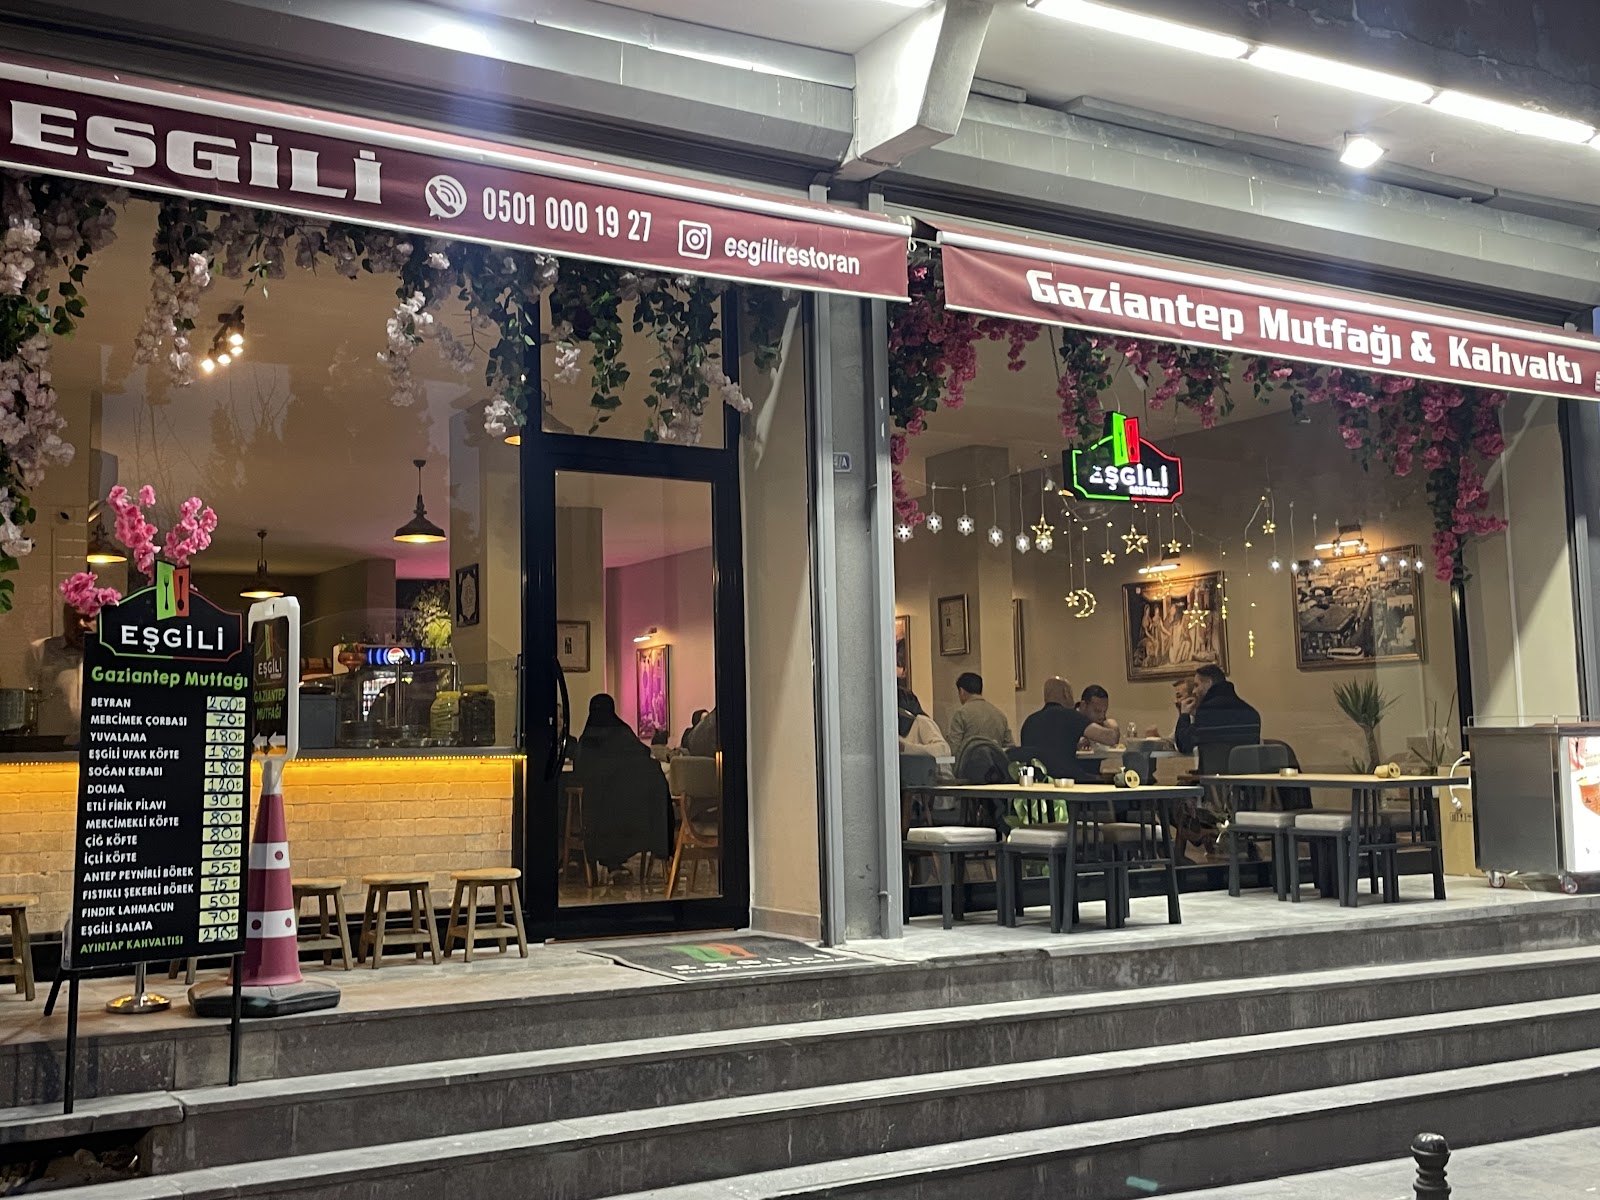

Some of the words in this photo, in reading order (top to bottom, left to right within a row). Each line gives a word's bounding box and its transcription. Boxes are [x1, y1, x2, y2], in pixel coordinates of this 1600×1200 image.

[10, 99, 382, 205] EŞGİLİ
[482, 186, 536, 226] 0501
[545, 196, 588, 234] 000
[595, 204, 620, 240] 19
[628, 210, 652, 243] 27
[724, 234, 860, 275] esgilirestoran
[1026, 269, 1244, 342] Gaziantep
[1258, 305, 1402, 366] Mutfağı
[1410, 330, 1434, 365] &
[1449, 335, 1582, 385] Kahvaltı
[121, 625, 224, 653] EŞGİLİ
[258, 656, 282, 679] EŞGİLİ
[91, 666, 180, 688] Gaziantep
[184, 671, 248, 691] Mutfağı
[91, 697, 131, 708] BEYRAN
[90, 712, 143, 725] MERCİMEK
[145, 716, 188, 727] ÇORBASI
[90, 732, 147, 742] YUVALAMA
[88, 746, 120, 760] EŞGİLİ
[122, 750, 147, 759] UFAK
[149, 747, 180, 759] KÖFTE
[88, 764, 126, 776] SOĞAN
[128, 766, 163, 776] KEBABI
[87, 784, 125, 794] DOLMA
[86, 798, 106, 812] ETLİ
[108, 798, 133, 811] FİRİK
[135, 798, 166, 811] PİLAVI
[85, 815, 147, 829] MERCİMEKLİ
[149, 814, 179, 827] KÖFTE
[85, 833, 104, 848] ÇİĞ
[106, 833, 138, 846] KÖFTE
[84, 851, 103, 866] İÇLİ
[105, 850, 137, 863] KÖFTE
[83, 871, 117, 882] ANTEP
[119, 865, 161, 880] PEYNİRLİ
[163, 865, 194, 878] BÖREK
[82, 888, 122, 900] FISTIKLI
[124, 883, 161, 899] ŞEKERLİ
[163, 882, 194, 895] BÖREK
[81, 906, 116, 918] FINDIK
[118, 902, 174, 915] LAHMACUN
[81, 921, 113, 937] EŞGİLİ
[115, 920, 153, 933] SALATA
[80, 940, 124, 954] AYINTAP
[126, 935, 183, 950] KAHVALTISI
